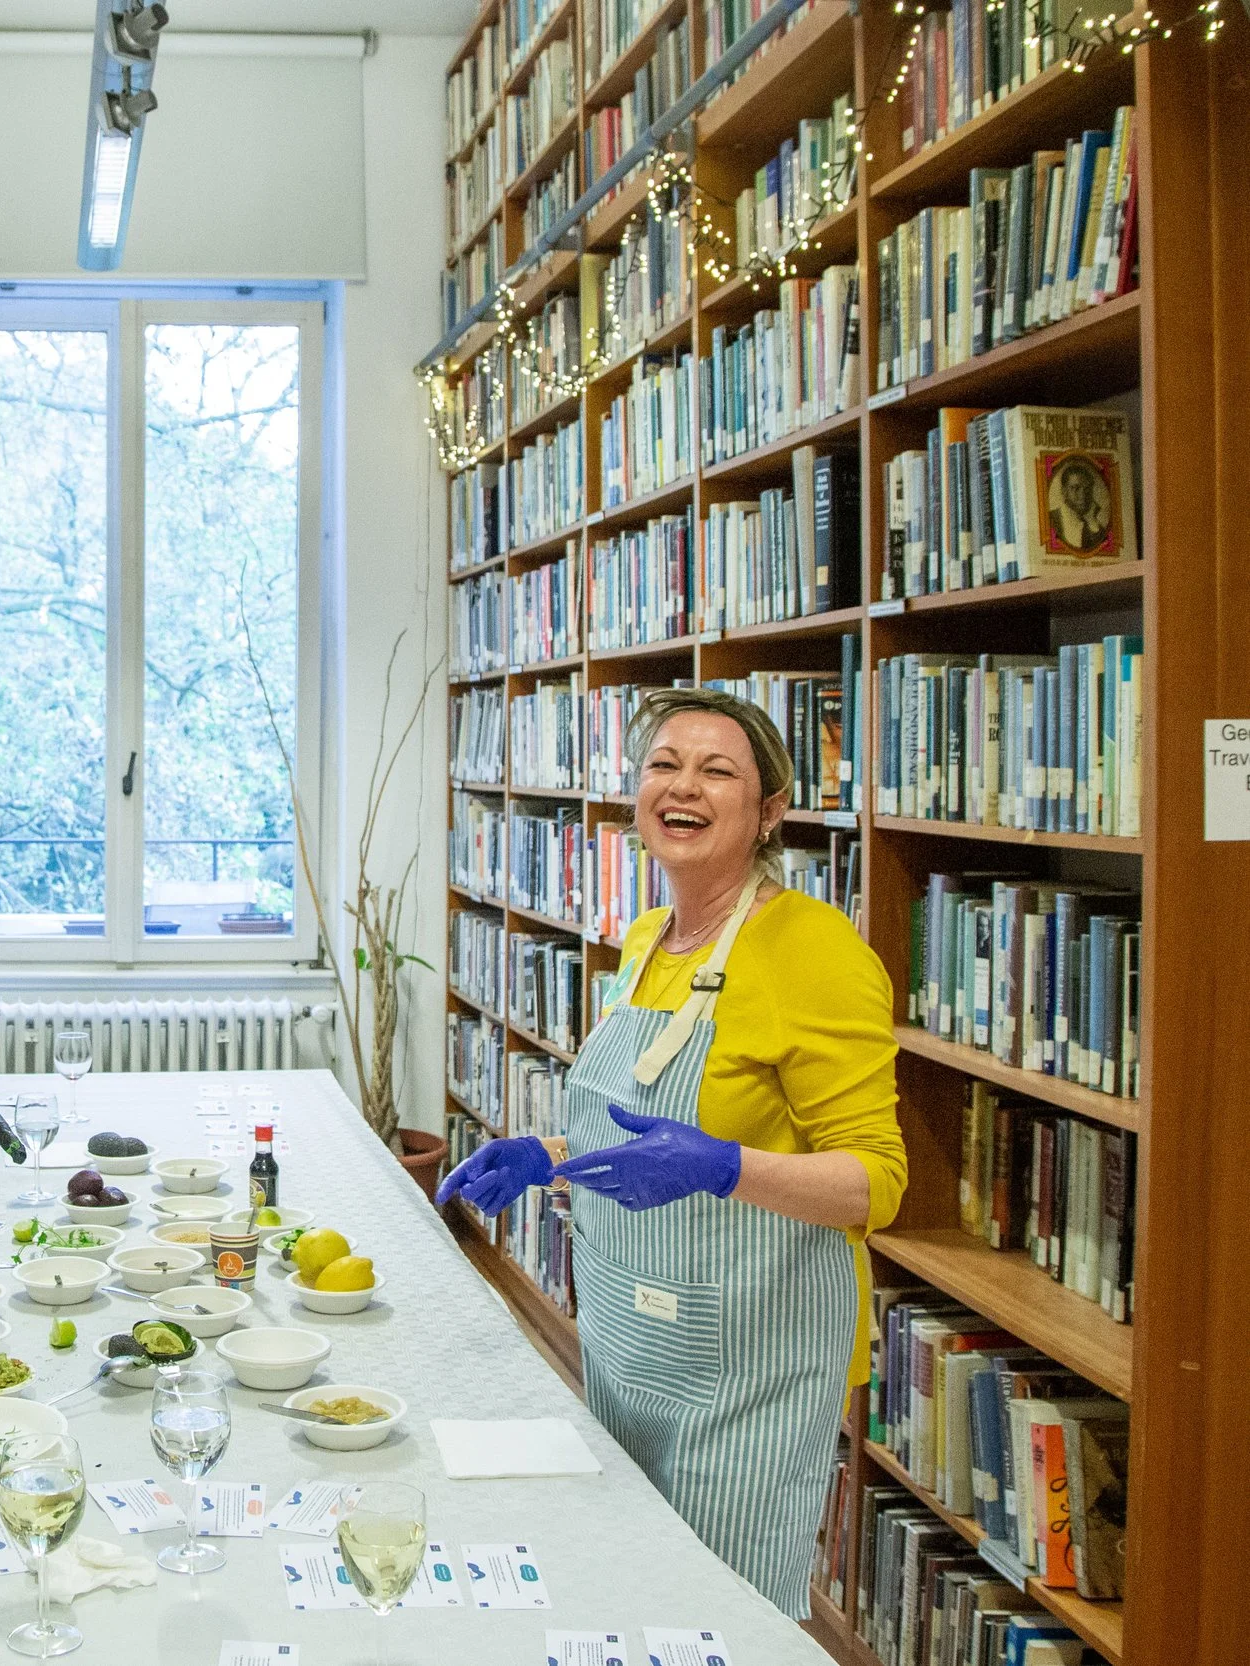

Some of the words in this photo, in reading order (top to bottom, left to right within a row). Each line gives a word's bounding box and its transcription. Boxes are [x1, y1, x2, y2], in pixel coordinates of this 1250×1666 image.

[909, 704, 919, 736] AND
[1221, 723, 1250, 742] Ge
[1209, 749, 1250, 766] Trav
